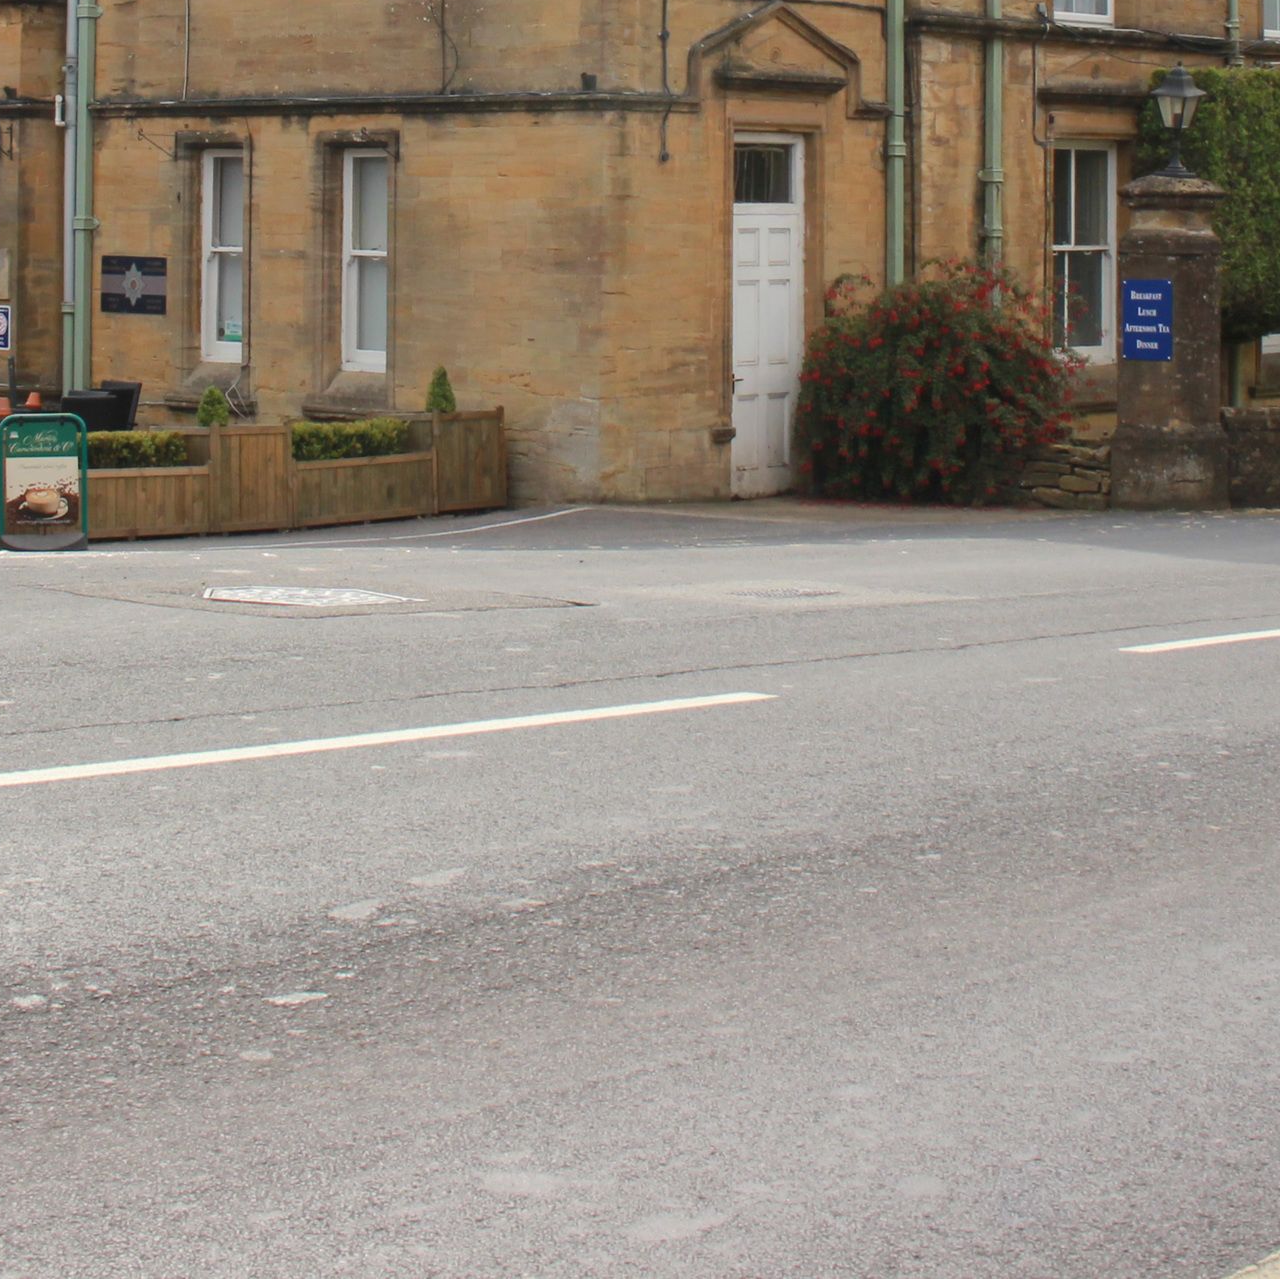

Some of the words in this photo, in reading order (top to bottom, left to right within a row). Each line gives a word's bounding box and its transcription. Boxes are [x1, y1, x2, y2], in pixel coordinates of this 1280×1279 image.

[1130, 290, 1162, 300] BREAKFAST
[1137, 306, 1157, 317] LUNCH
[1125, 323, 1157, 333] AFTERNOON
[1157, 323, 1170, 333] TEA
[1136, 339, 1159, 349] DINNER
